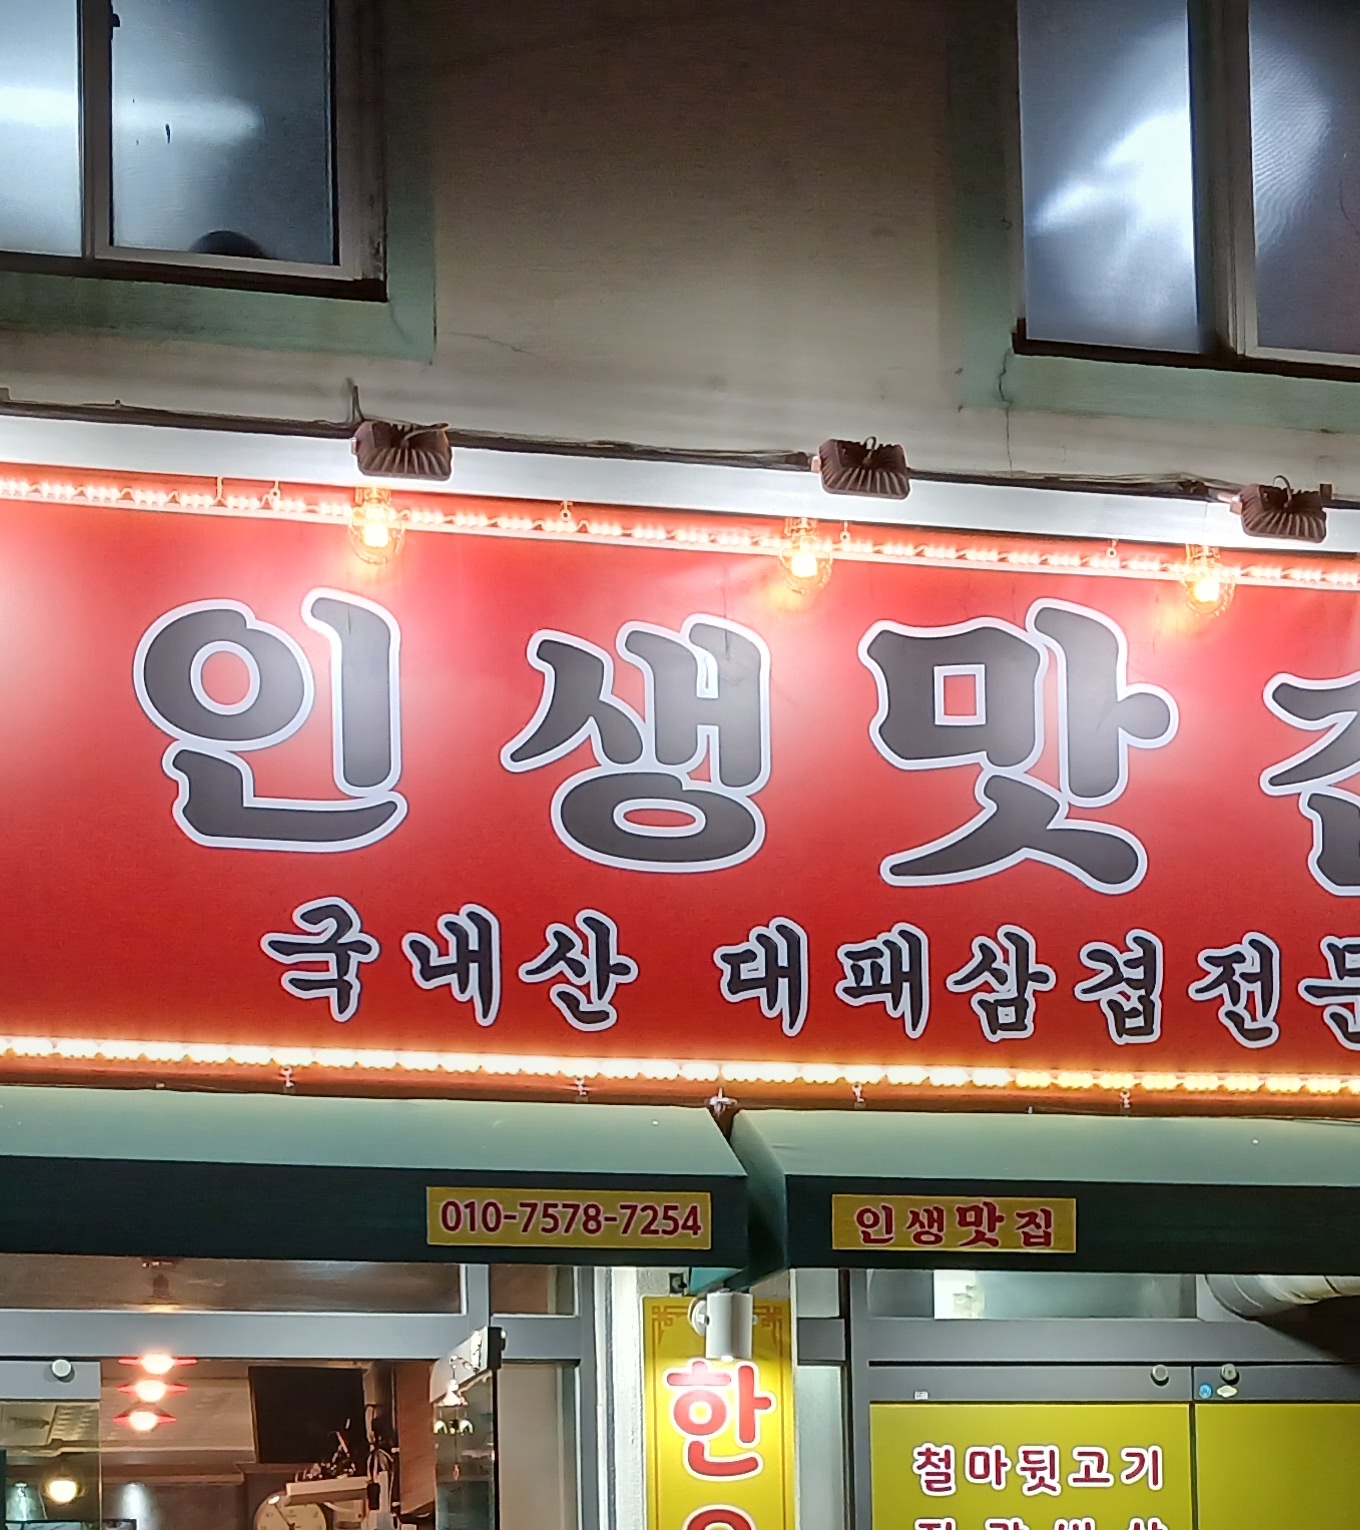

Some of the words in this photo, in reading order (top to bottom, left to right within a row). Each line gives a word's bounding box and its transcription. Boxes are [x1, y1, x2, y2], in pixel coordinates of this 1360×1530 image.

[264, 898, 636, 1031] 국내산
[440, 1199, 703, 1240] 010-7578-7254
[854, 1201, 1054, 1247] 인생맛집
[915, 1445, 1161, 1495] 철마뒷고기
